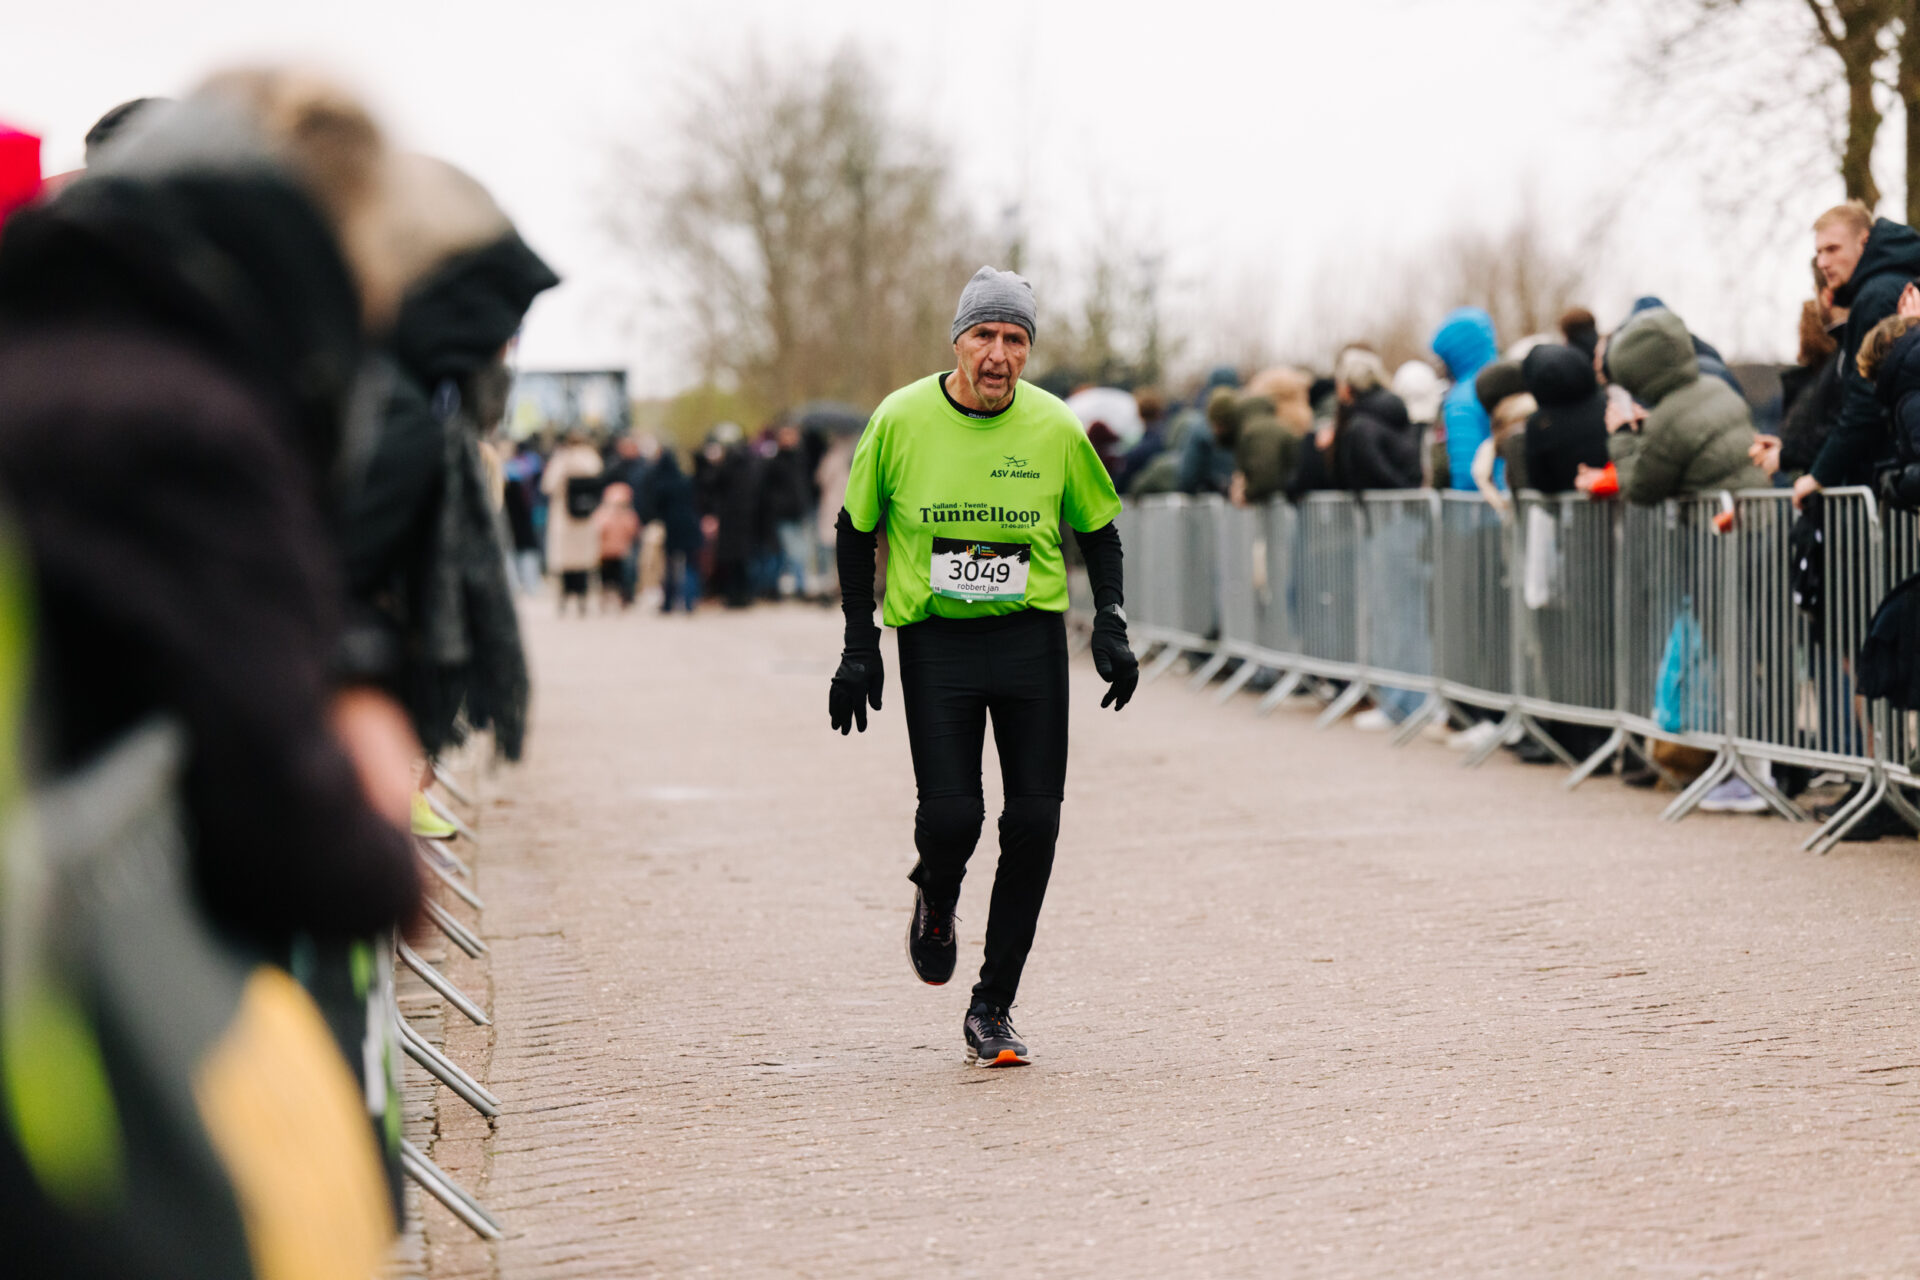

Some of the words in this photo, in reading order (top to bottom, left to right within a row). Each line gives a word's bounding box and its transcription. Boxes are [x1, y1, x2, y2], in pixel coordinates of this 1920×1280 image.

[990, 469, 1009, 478] ASV
[1010, 469, 1040, 479] Atletics
[919, 506, 1040, 527] Tunnelloop
[948, 559, 1010, 583] 3049
[957, 583, 986, 592] robbert
[986, 585, 1000, 594] jan
